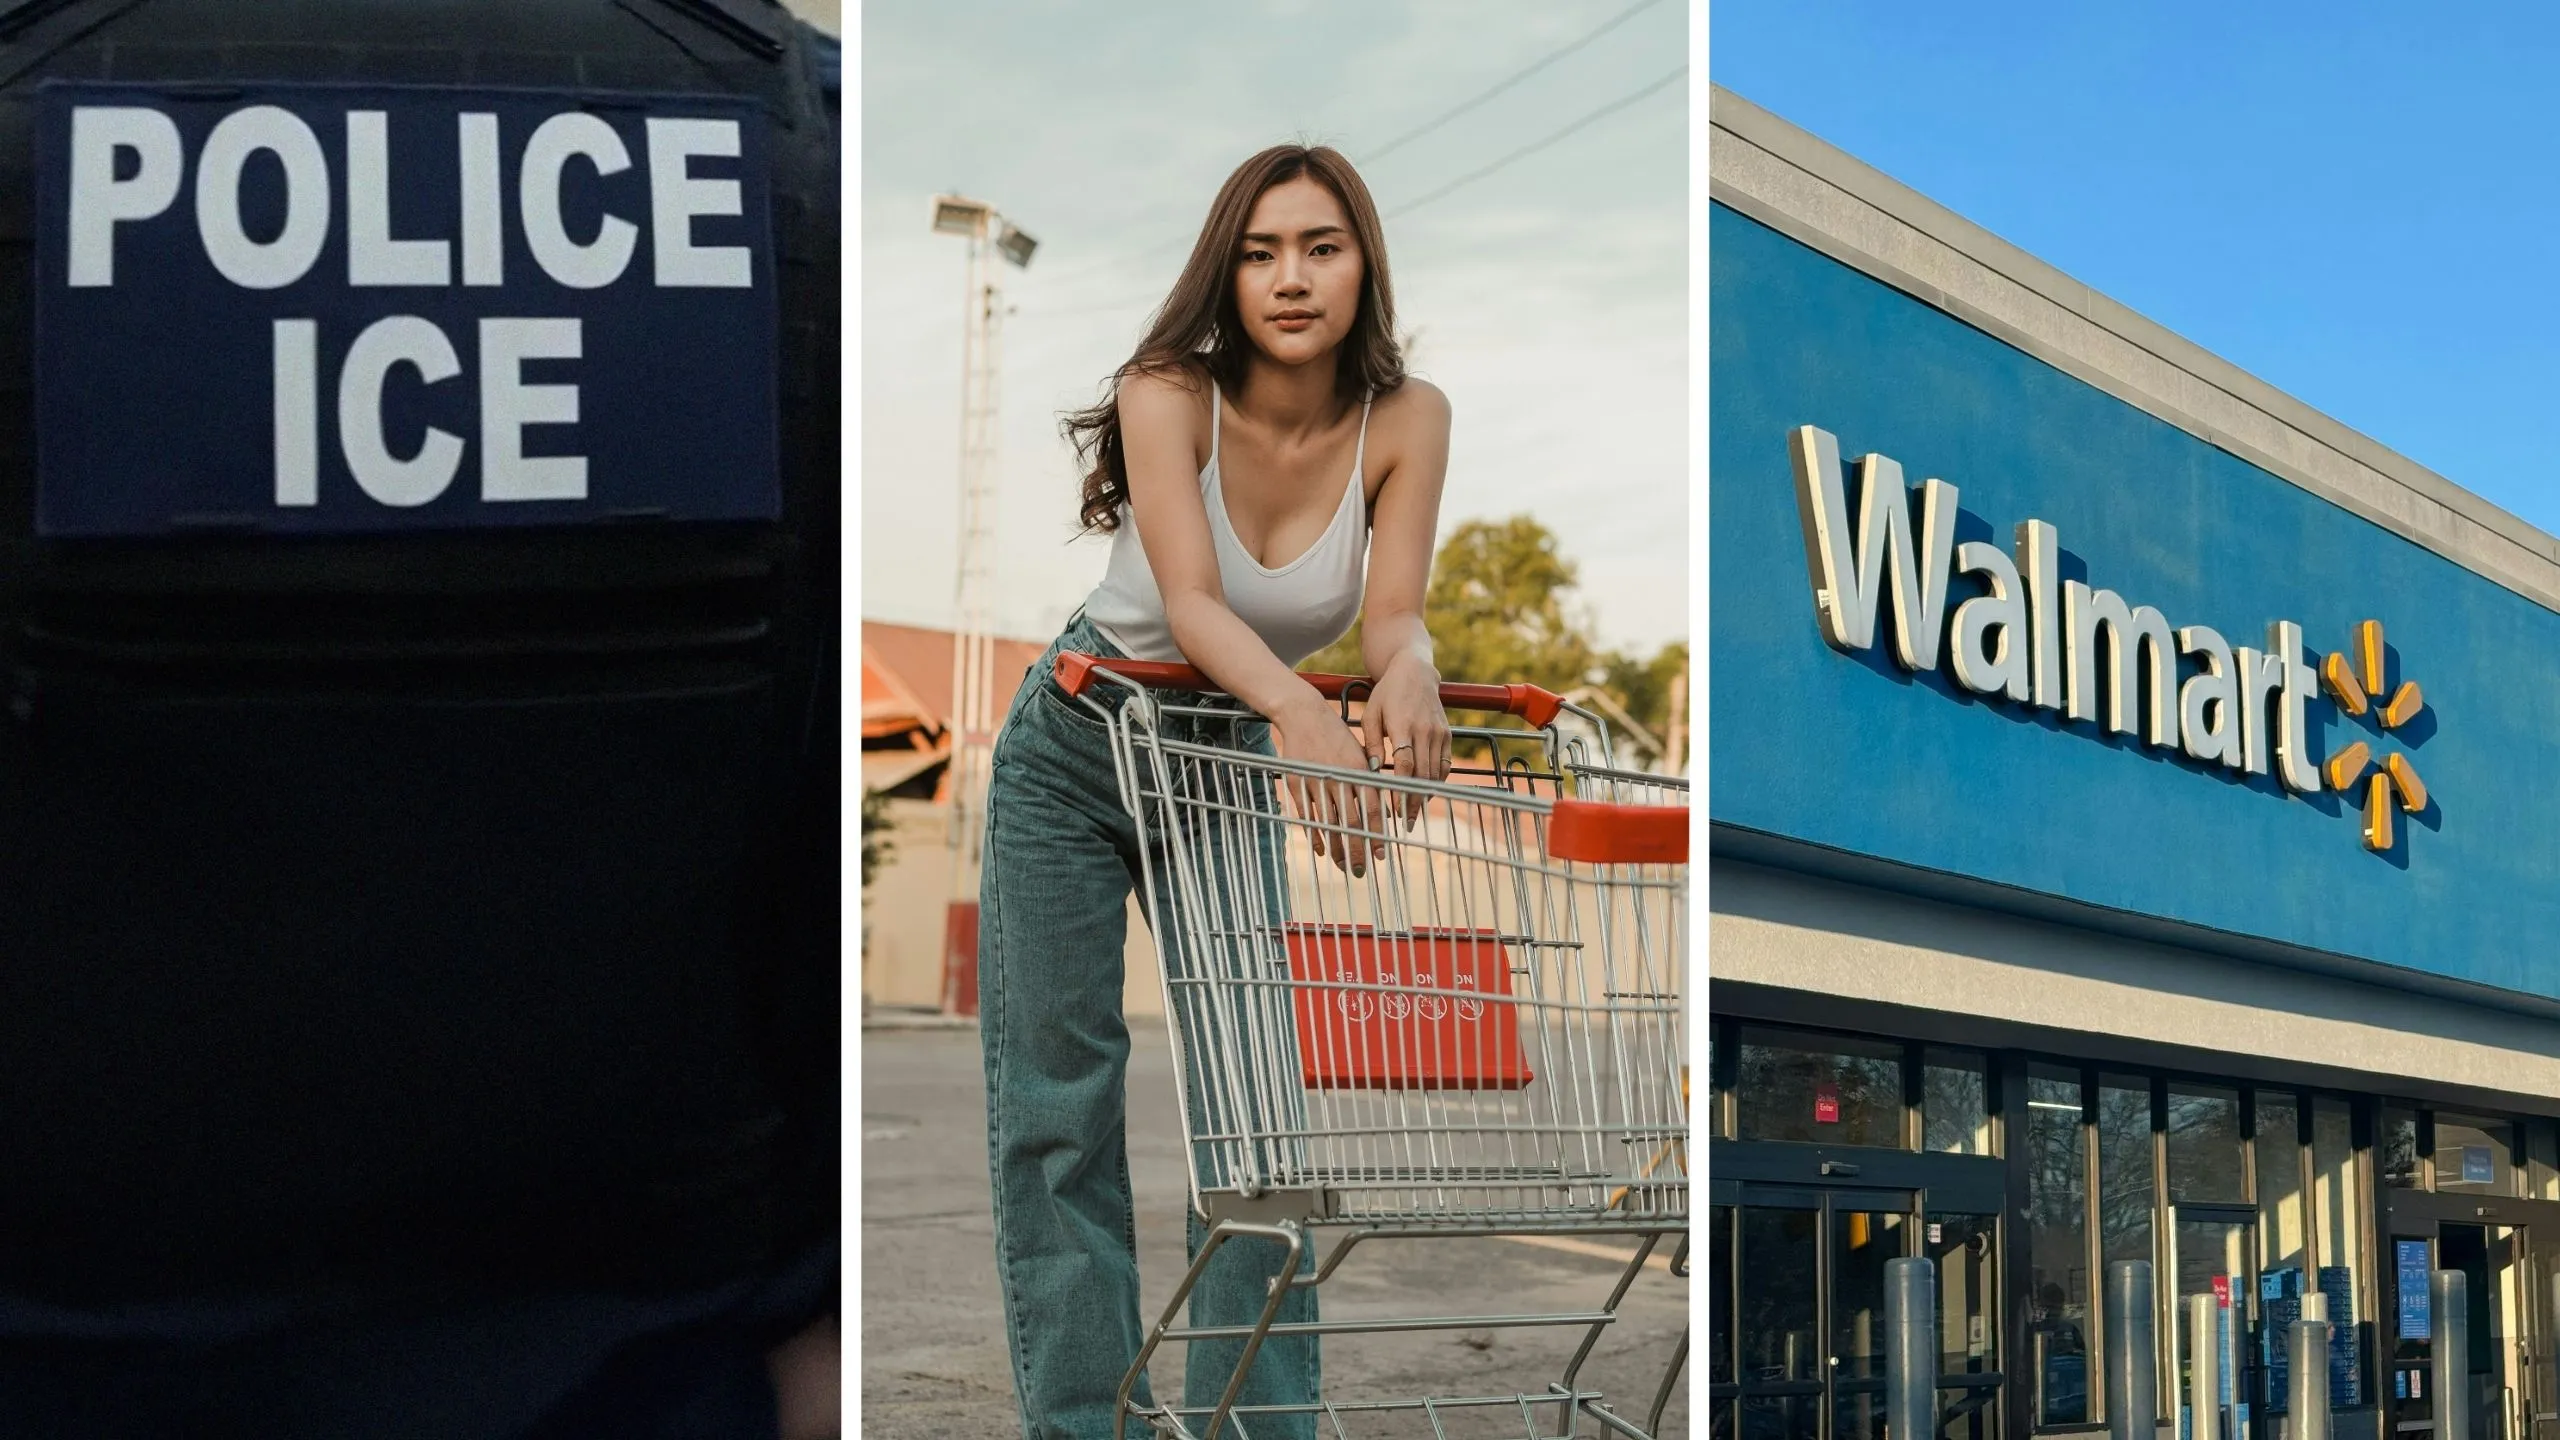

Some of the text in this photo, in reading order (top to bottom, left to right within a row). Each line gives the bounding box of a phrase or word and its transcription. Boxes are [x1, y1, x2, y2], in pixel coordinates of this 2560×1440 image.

[67, 105, 753, 289] POLICE
[273, 315, 589, 507] ICE
[1789, 424, 2320, 792] Walmart
